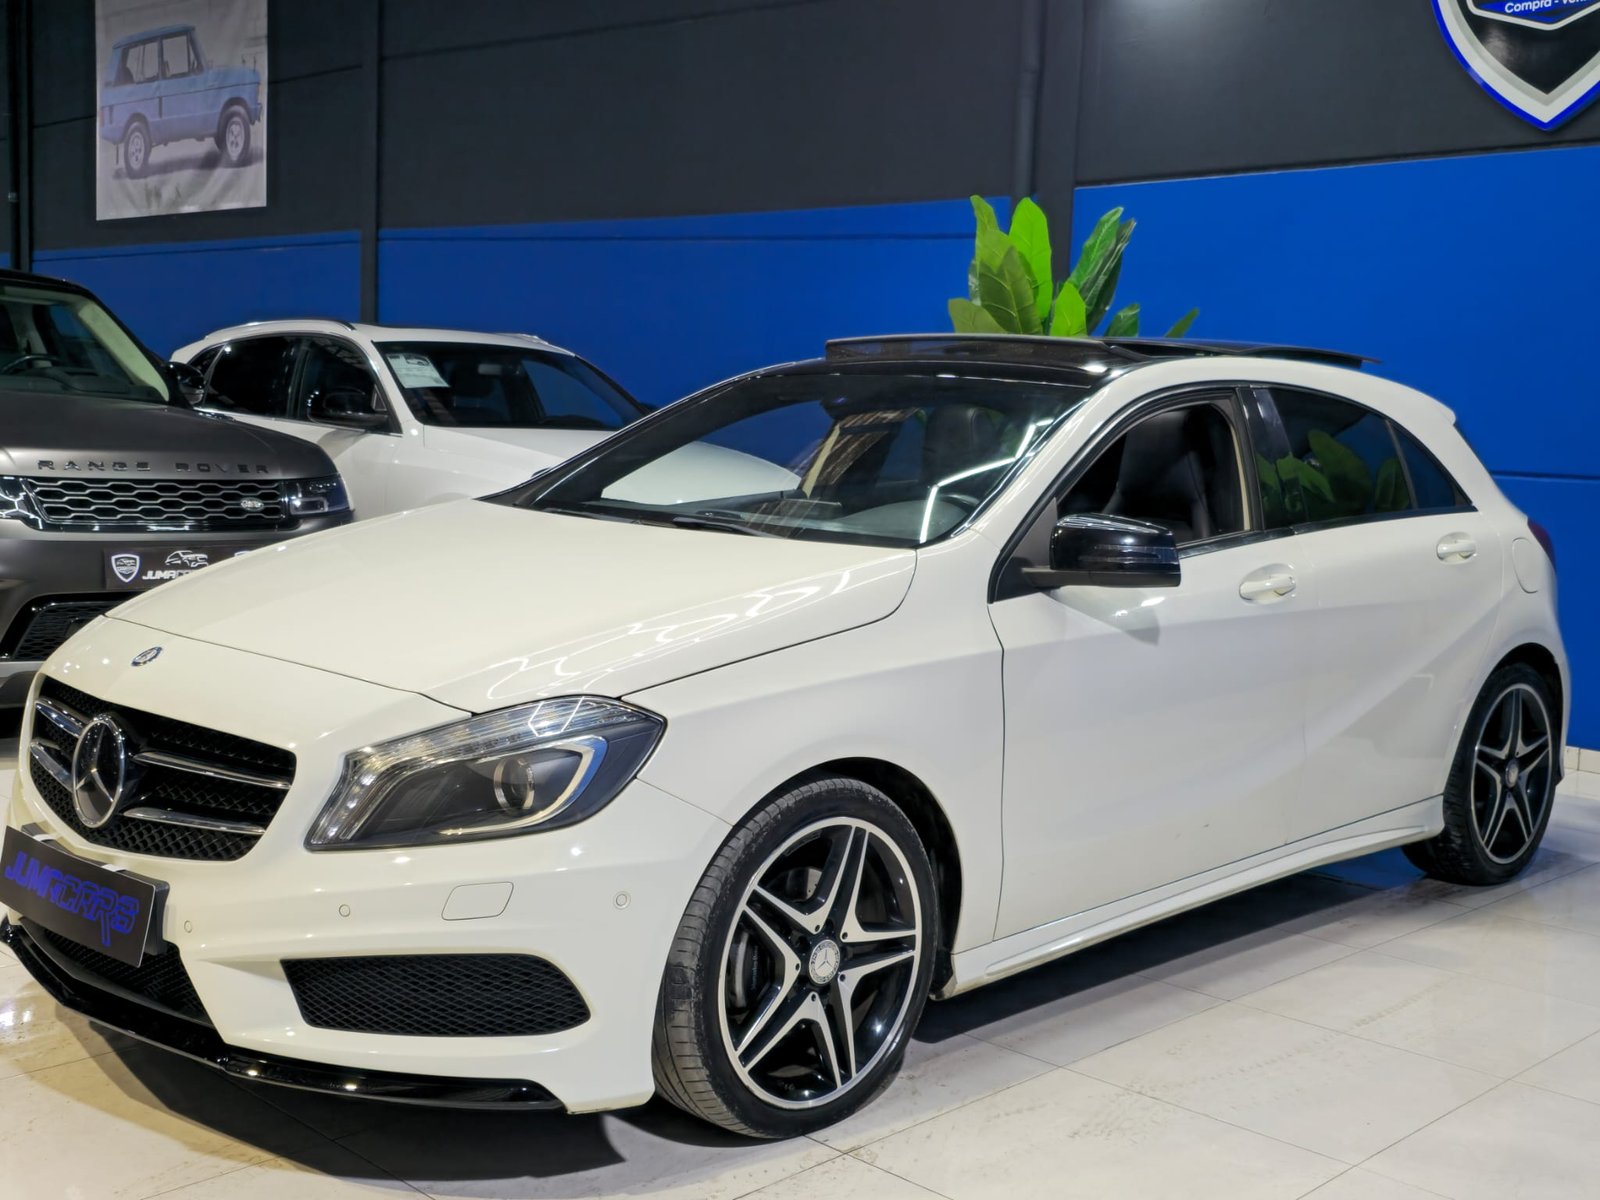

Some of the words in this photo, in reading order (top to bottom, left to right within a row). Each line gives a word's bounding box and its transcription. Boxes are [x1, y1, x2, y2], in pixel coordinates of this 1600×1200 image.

[1504, 0, 1552, 13] Compra
[38, 460, 150, 471] RANGE
[175, 463, 269, 473] ROVER
